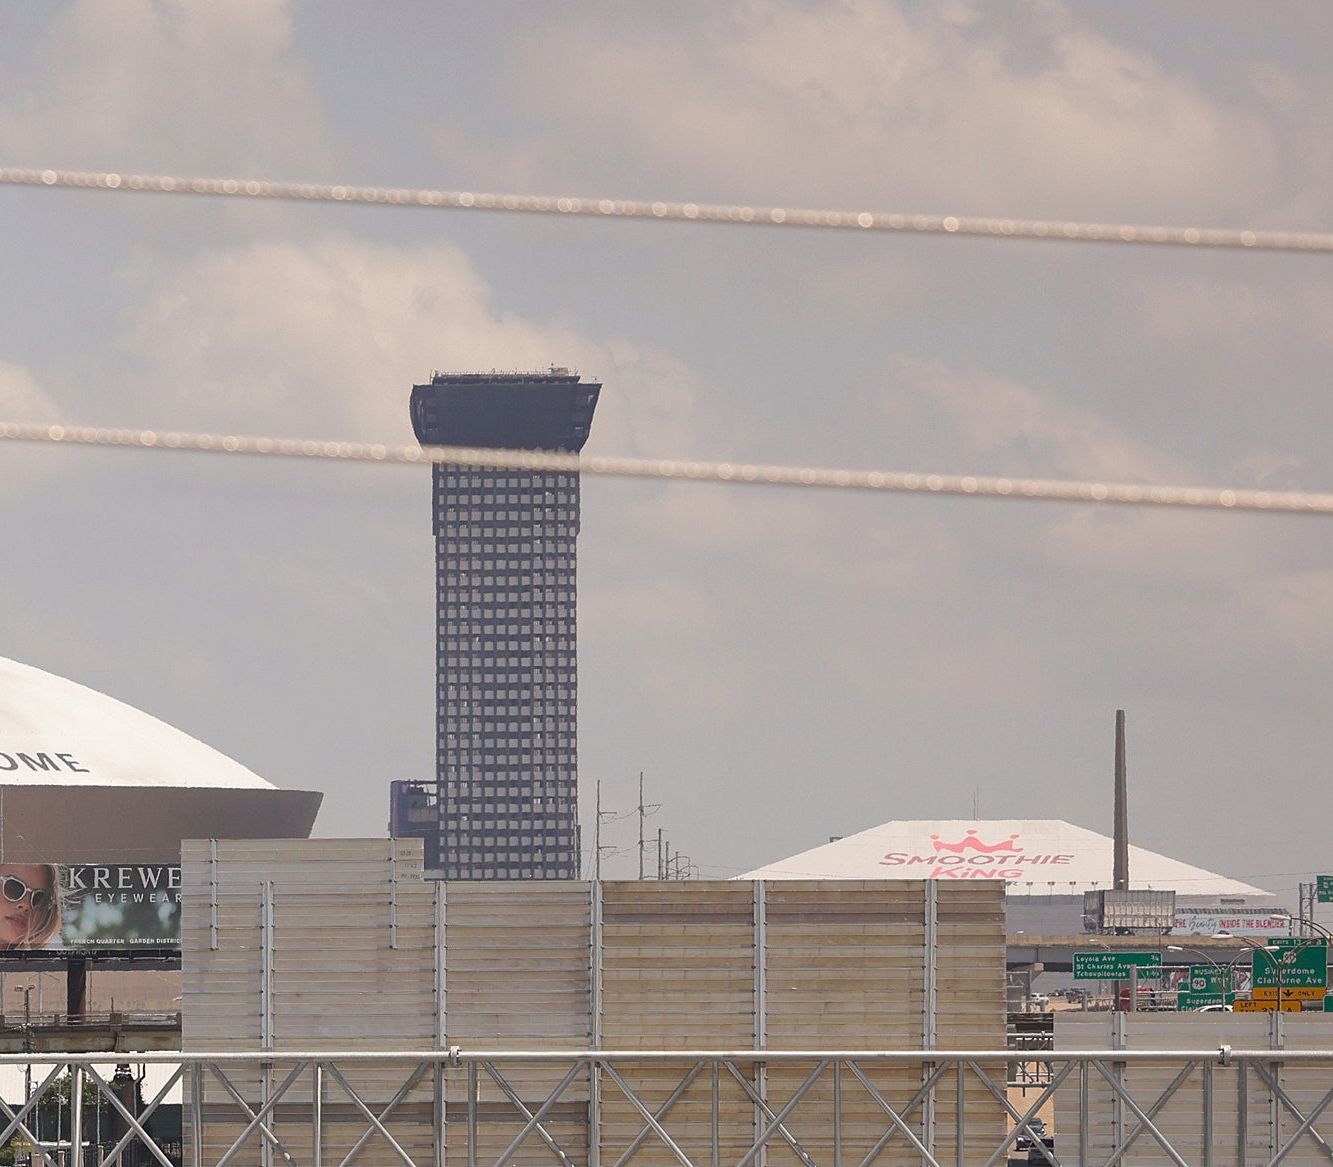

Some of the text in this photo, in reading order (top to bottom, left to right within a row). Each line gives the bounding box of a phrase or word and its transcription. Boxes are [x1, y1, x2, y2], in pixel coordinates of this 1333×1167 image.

[878, 853, 1076, 866] SMOOTHIE
[68, 867, 181, 889] KREWE
[95, 893, 181, 903] EYEWEAR
